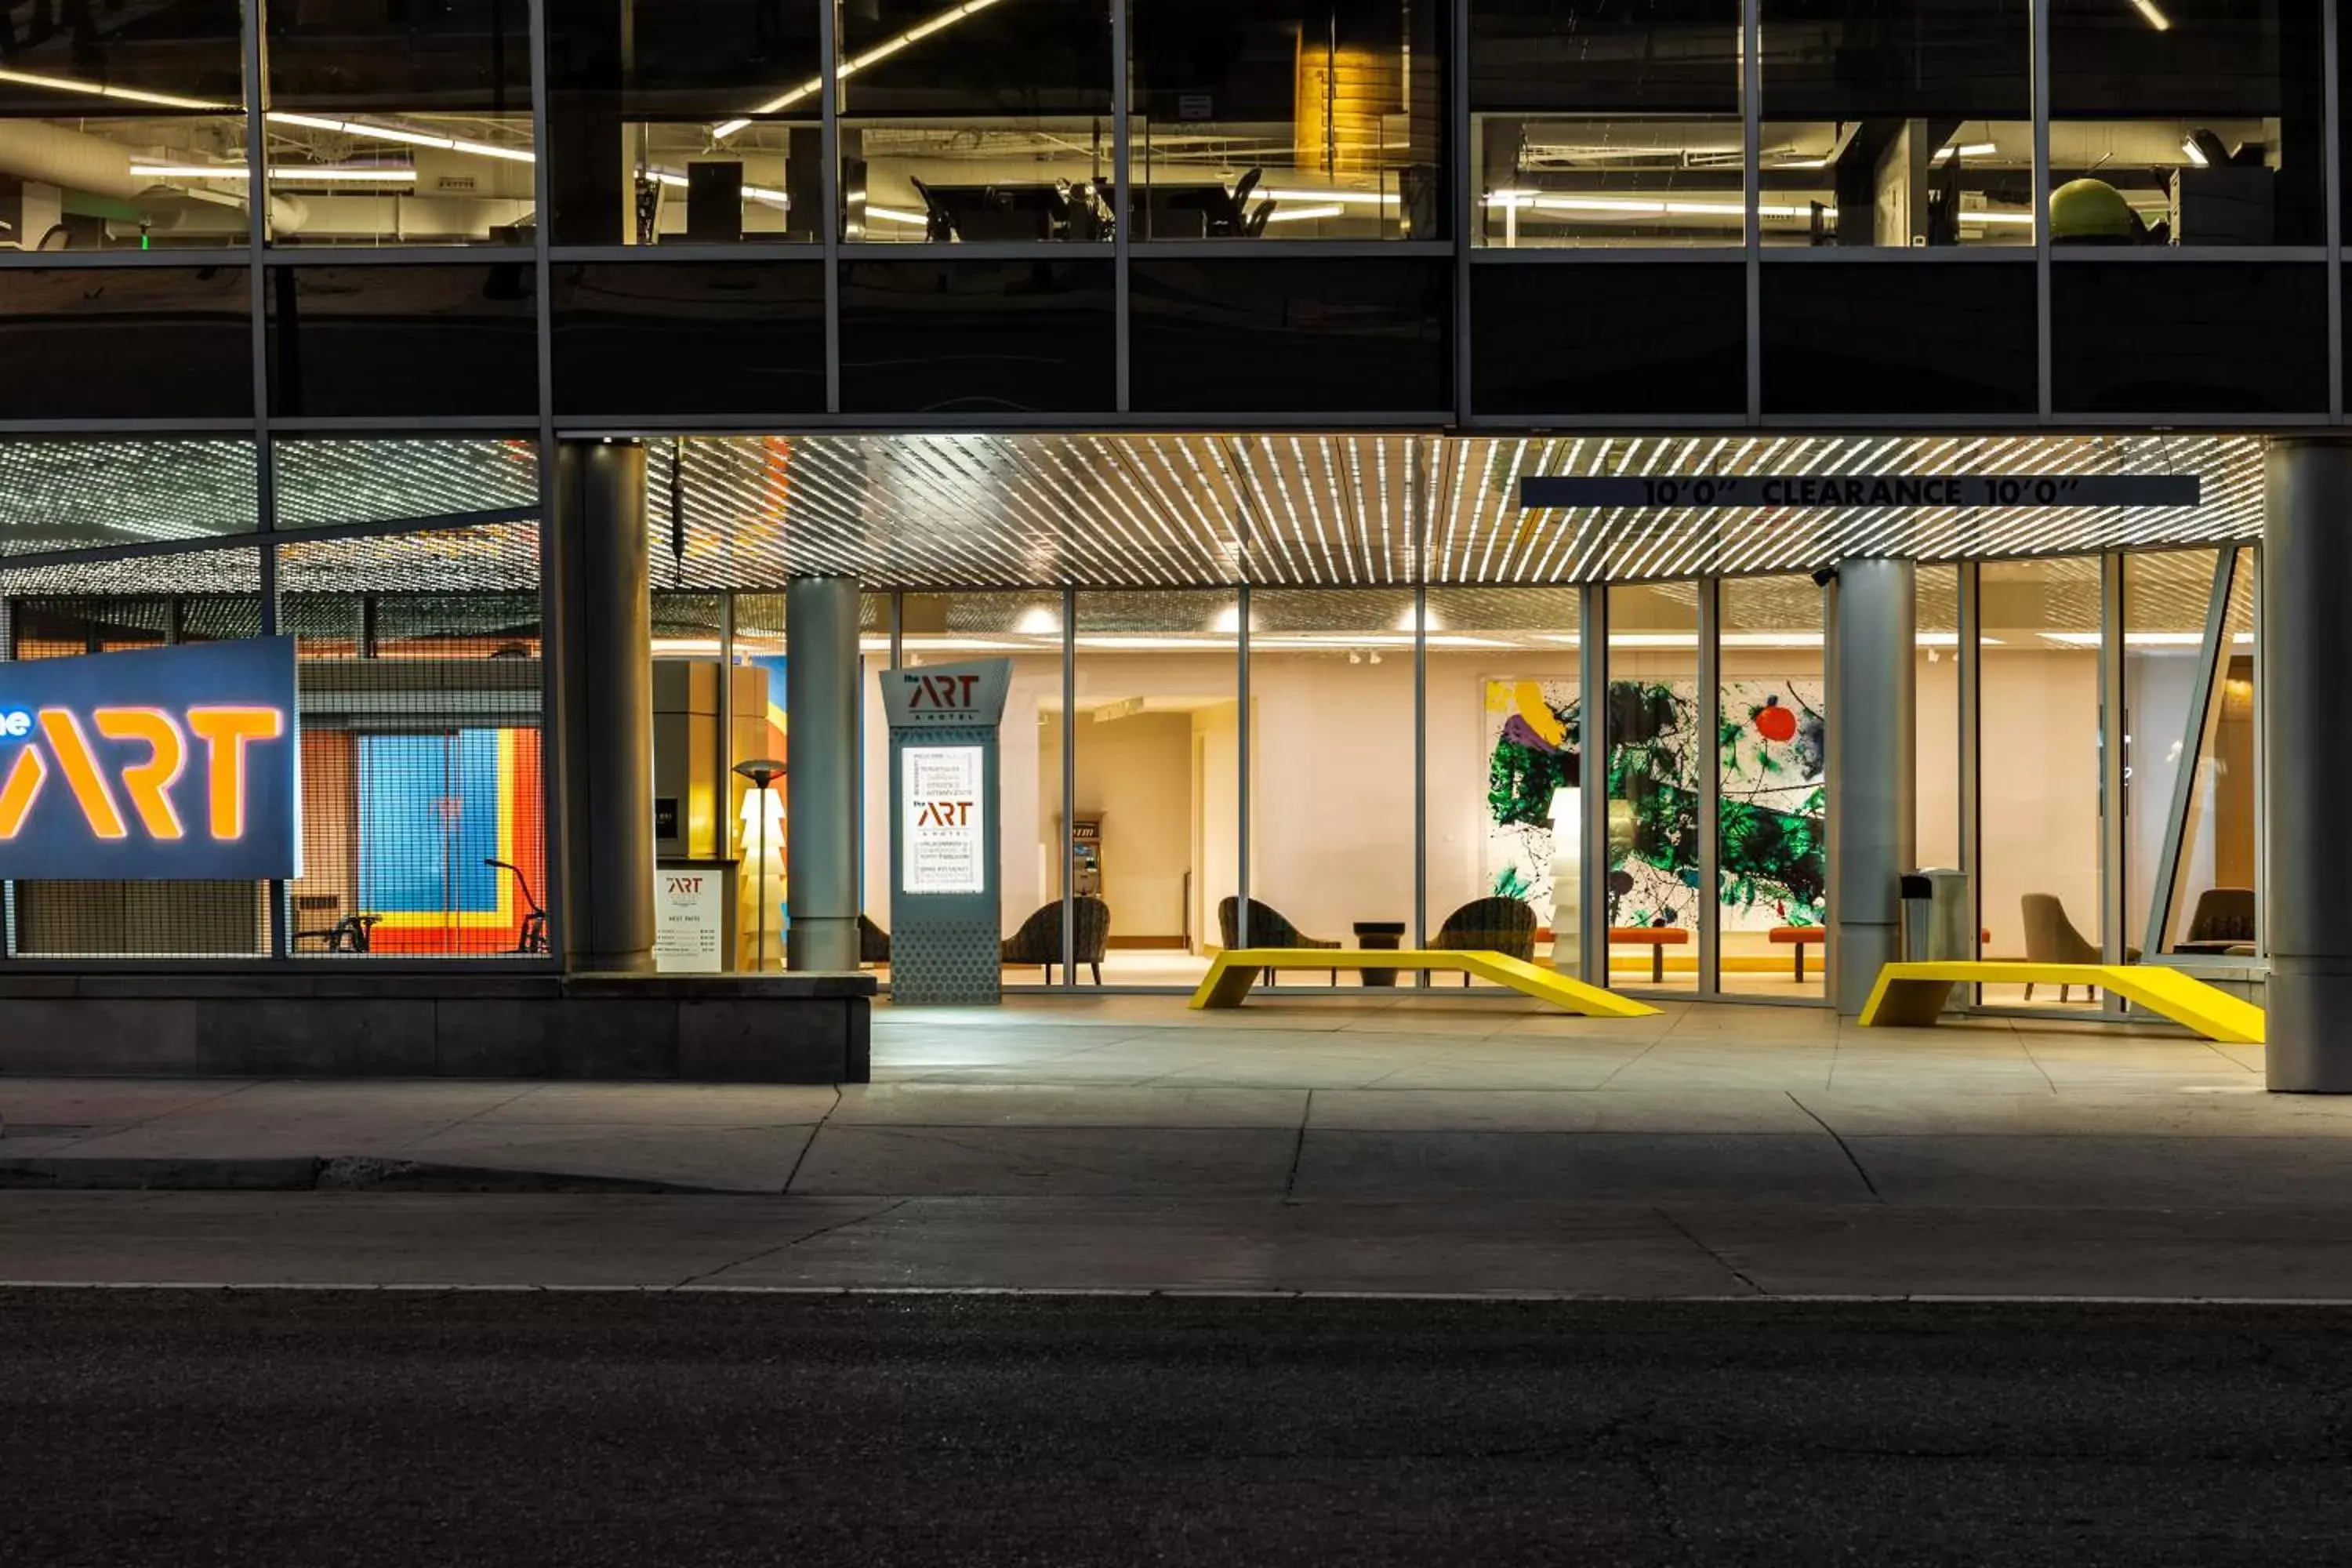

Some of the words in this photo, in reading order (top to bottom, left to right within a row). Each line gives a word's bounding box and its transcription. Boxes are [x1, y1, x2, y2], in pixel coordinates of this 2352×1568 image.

[1762, 479, 1963, 506] CLEARANCE
[909, 675, 979, 708] ART
[0, 707, 283, 840] ART
[917, 801, 974, 826] ART
[667, 877, 703, 893] ART
